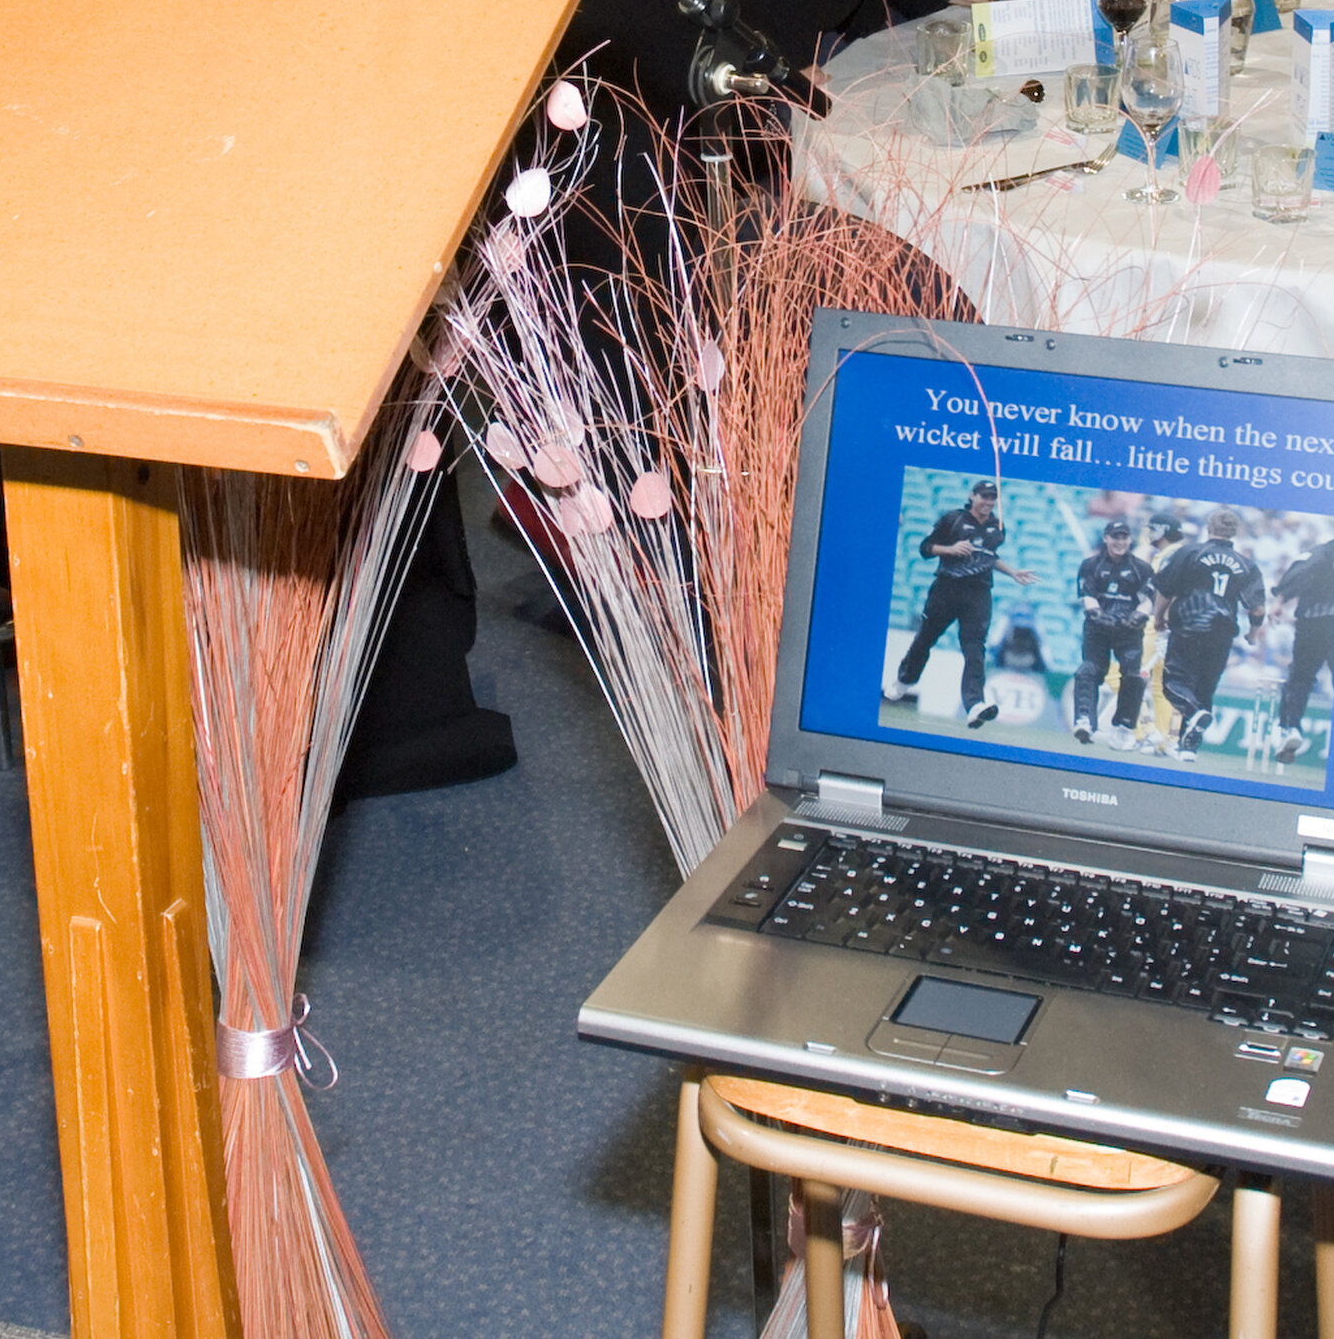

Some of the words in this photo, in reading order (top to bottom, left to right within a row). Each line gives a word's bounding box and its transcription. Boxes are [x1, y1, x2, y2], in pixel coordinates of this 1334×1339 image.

[925, 388, 980, 417] You
[987, 399, 1063, 425] never
[1068, 404, 1144, 434] know
[1153, 416, 1226, 444] when
[1234, 422, 1278, 449] the
[895, 421, 981, 450] wicket
[991, 431, 1040, 458] will
[1197, 455, 1282, 488] things
[1062, 787, 1119, 806] TOSHIBA
